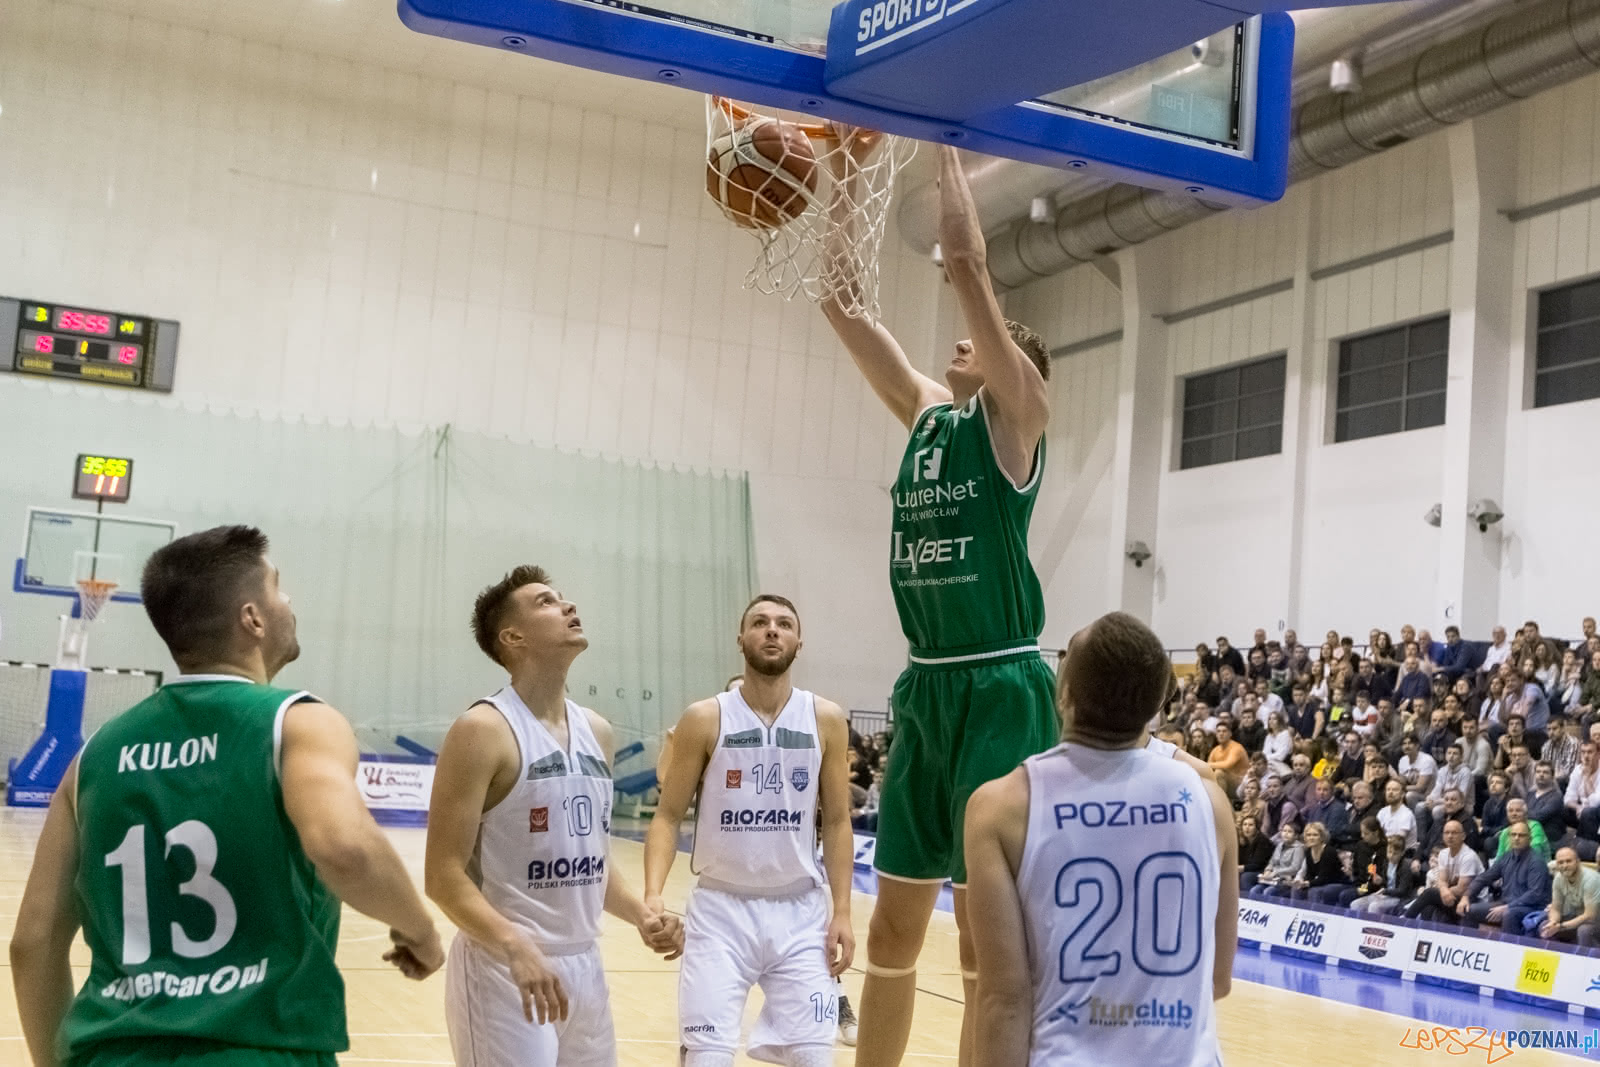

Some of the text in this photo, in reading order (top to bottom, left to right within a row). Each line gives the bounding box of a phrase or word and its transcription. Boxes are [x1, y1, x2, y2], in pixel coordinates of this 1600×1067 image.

[118, 733, 219, 774] KULON
[752, 763, 784, 795] 14
[563, 795, 592, 837] 10
[720, 809, 802, 825] BIOFARM
[104, 820, 238, 965] 13
[1055, 851, 1202, 984] 20
[1295, 920, 1325, 947] PBG
[1434, 945, 1491, 972] NICKEL
[810, 991, 838, 1025] 14
[1090, 997, 1193, 1020] funclub
